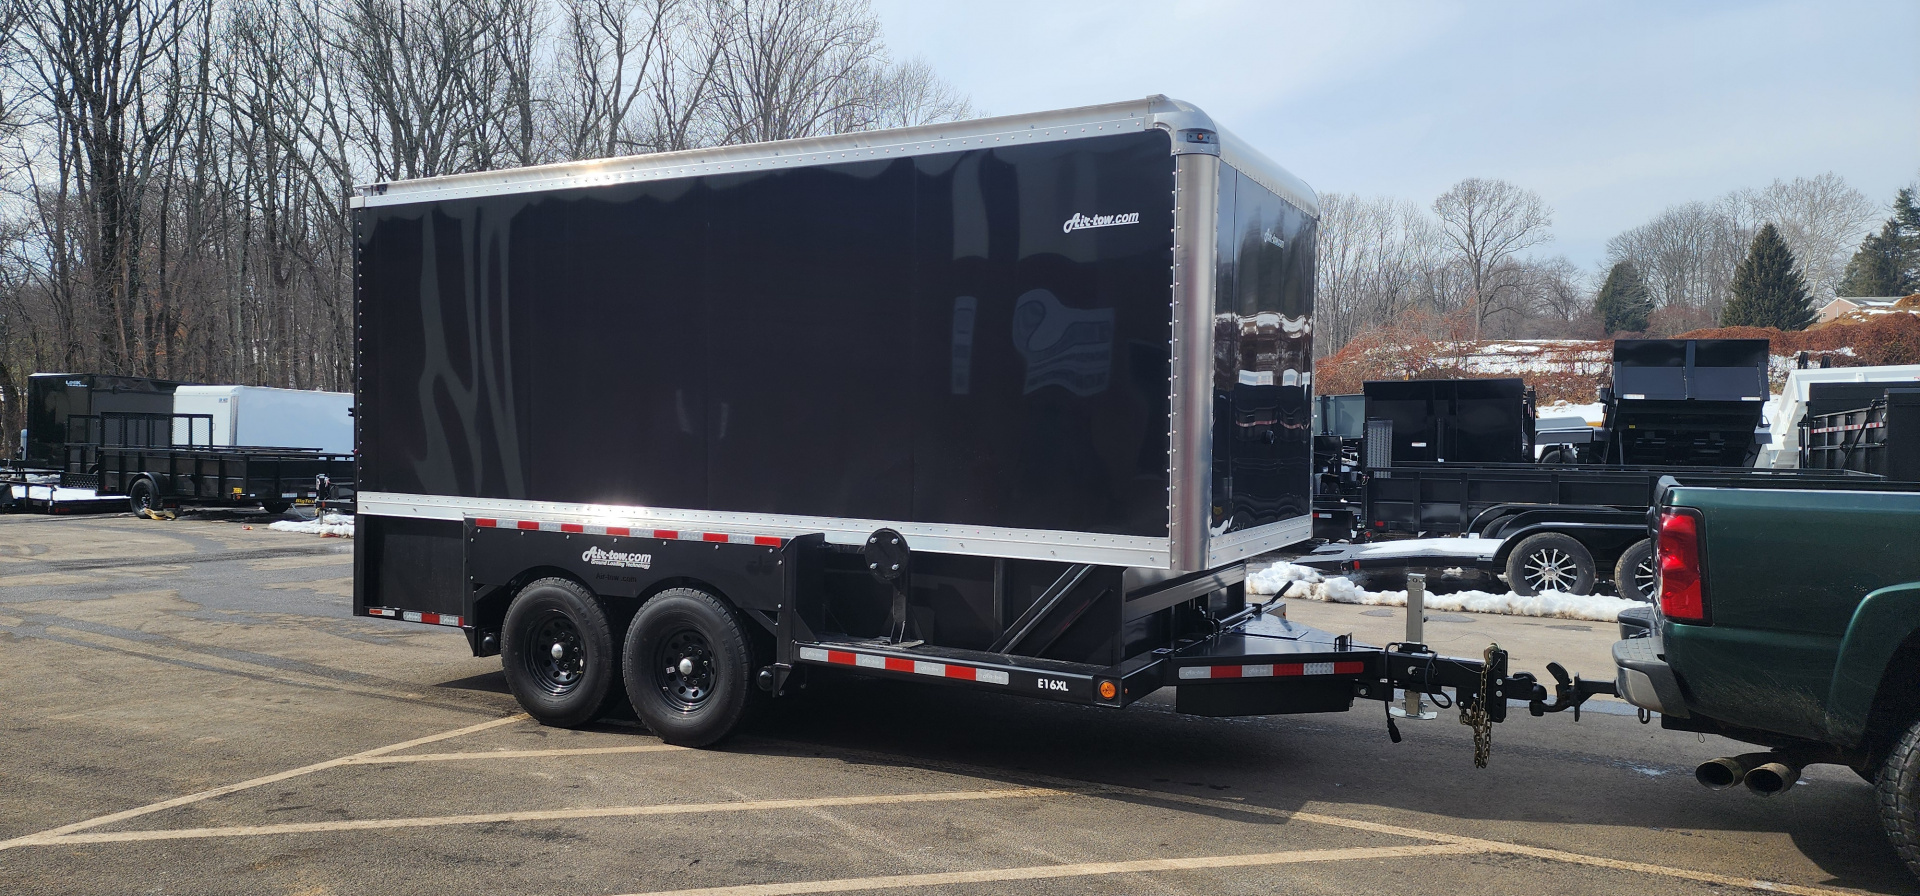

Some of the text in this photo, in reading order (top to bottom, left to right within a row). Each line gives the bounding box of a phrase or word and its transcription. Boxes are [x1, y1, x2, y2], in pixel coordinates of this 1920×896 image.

[1063, 212, 1140, 233] Air-tow.com
[582, 546, 652, 563] Air-tow.com
[625, 561, 651, 570] Technology
[1038, 678, 1069, 692] E16XL
